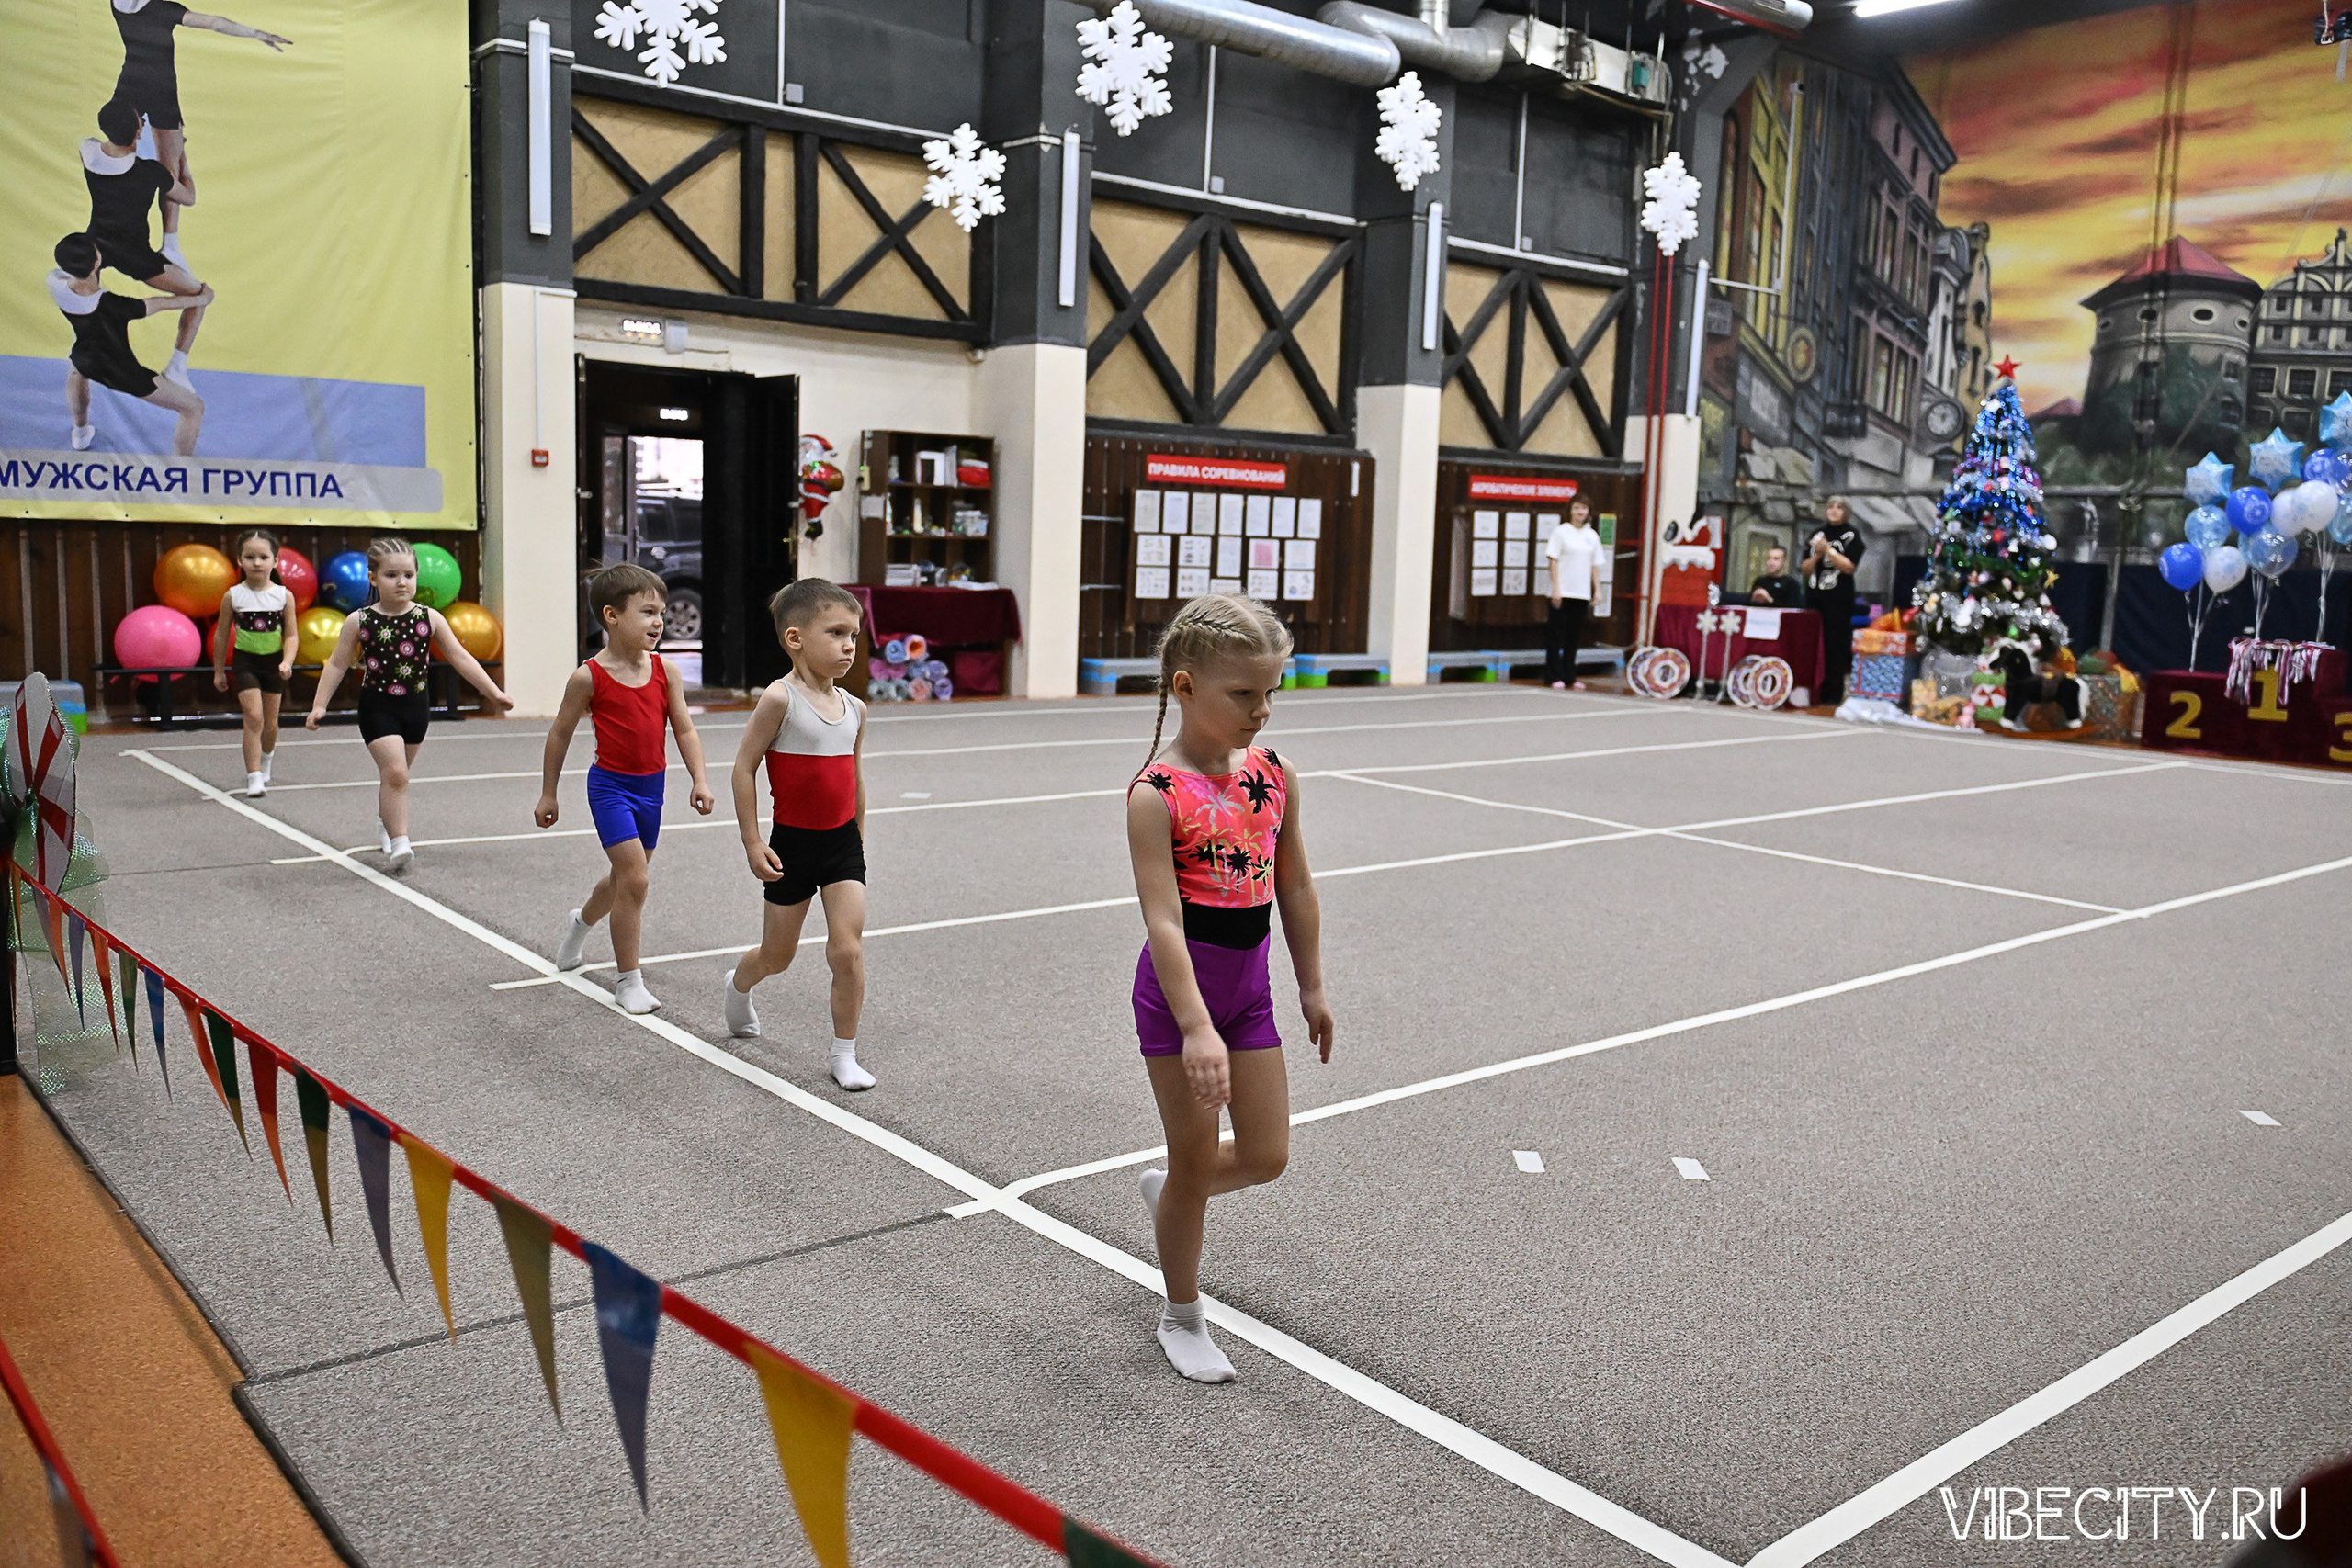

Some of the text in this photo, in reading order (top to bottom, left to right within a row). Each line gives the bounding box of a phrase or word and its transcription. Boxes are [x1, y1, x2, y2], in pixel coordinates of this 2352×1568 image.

[0, 459, 344, 498] МУЖСКАЯ ГРУППА
[1148, 462, 1200, 477] ПРАВИЛА
[2165, 690, 2202, 739] 2
[2247, 663, 2288, 722] 1
[2329, 711, 2352, 762] 3
